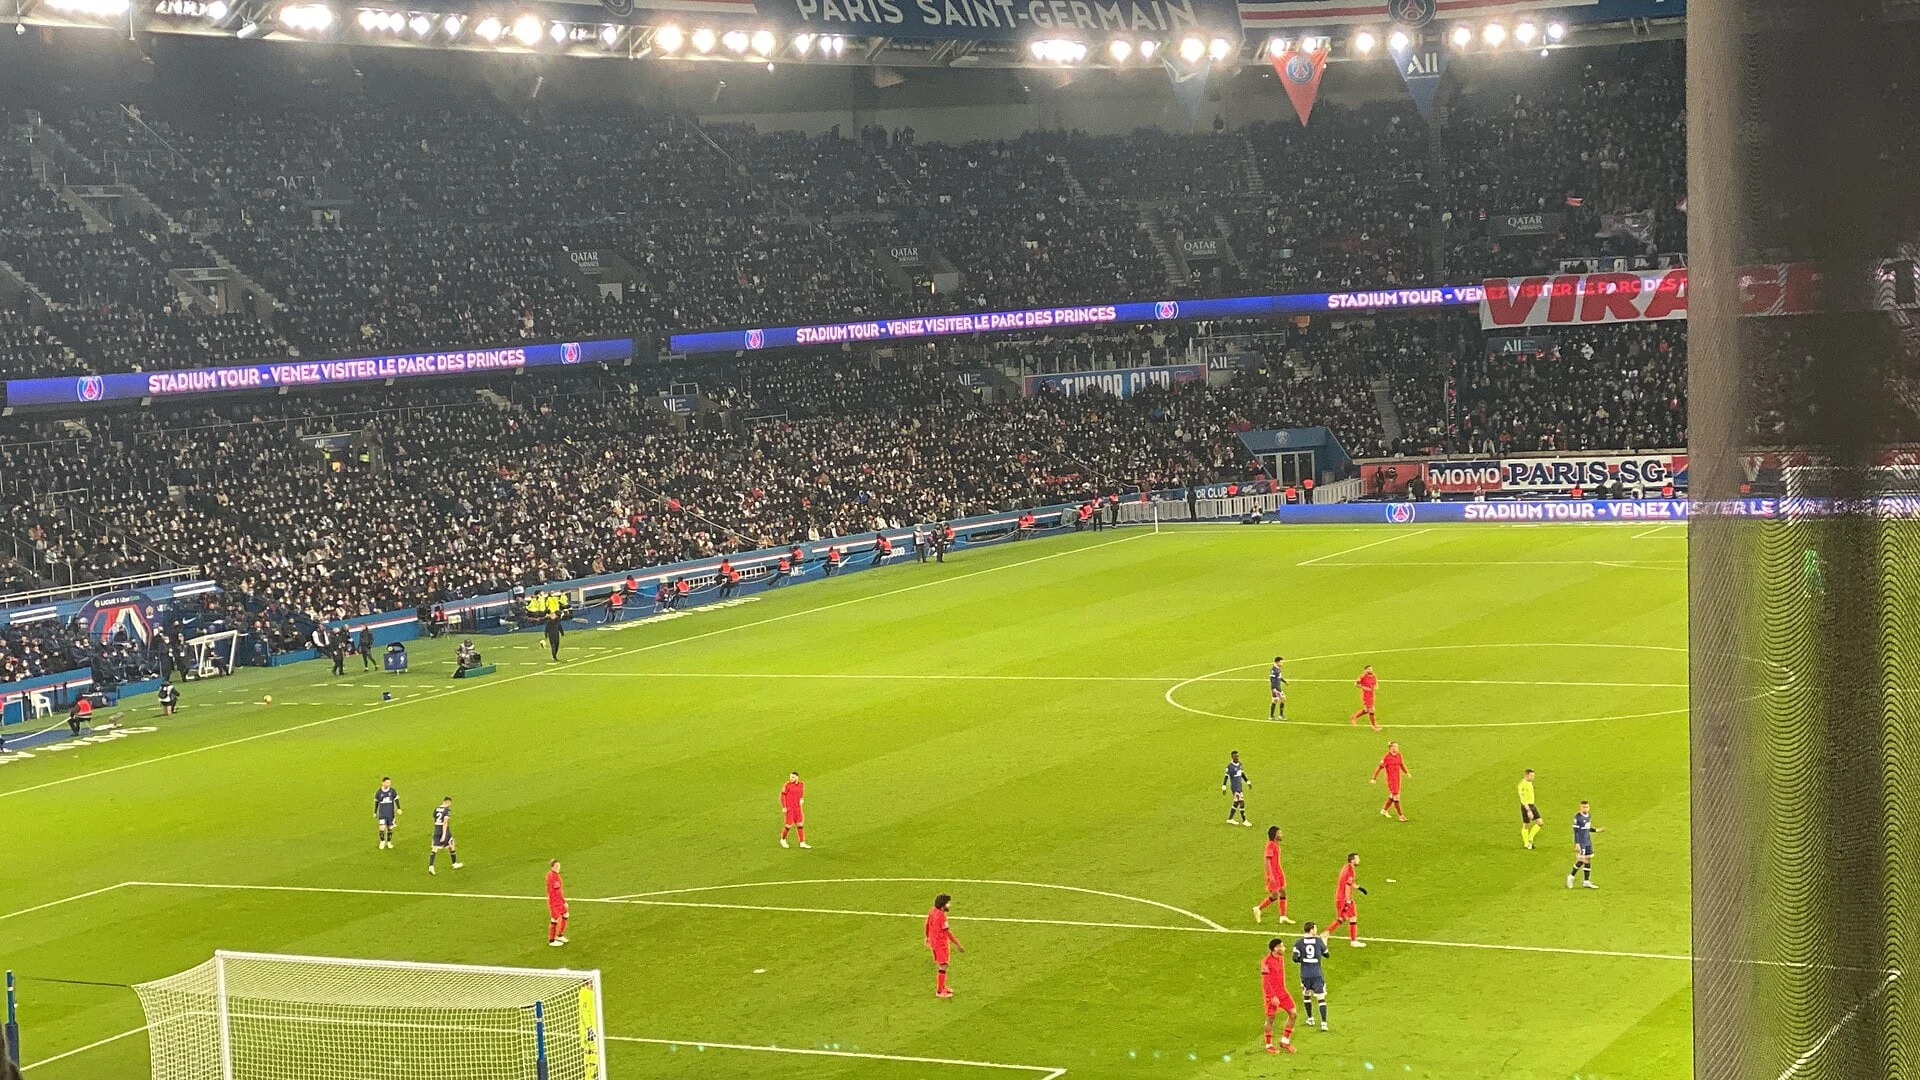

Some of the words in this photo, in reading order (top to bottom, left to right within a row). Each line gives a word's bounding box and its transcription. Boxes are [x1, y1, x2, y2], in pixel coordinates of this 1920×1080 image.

[797, 0, 904, 24] PARIS
[917, 0, 1201, 31] SAINT-GERMAIN
[1507, 215, 1543, 227] QATAR
[890, 247, 918, 259] QATAR
[1183, 240, 1217, 251] QATAR
[570, 251, 599, 264] QATAR
[1327, 293, 1397, 308] STADIUM
[1398, 290, 1443, 305] TOUR
[1453, 286, 1507, 301] VENEZ
[796, 327, 847, 343] STADIUM
[849, 324, 880, 338] TOUR
[887, 319, 924, 335] VENEZ
[924, 317, 973, 333] VISITER
[974, 316, 990, 330] LE
[991, 313, 1024, 328] PARC
[1025, 311, 1053, 325] DES
[1054, 306, 1117, 323] PRINCES
[148, 371, 217, 394] STADIUM
[217, 368, 260, 387] TOUR
[270, 364, 320, 383] VENEZ
[321, 360, 377, 380] VISITER
[379, 359, 396, 376] LE
[397, 356, 435, 374] PARC
[437, 353, 465, 371] DES
[466, 349, 525, 368] PRINCES
[1429, 466, 1501, 486] MOMO
[1508, 460, 1611, 486] PARIS
[1617, 459, 1667, 483] SG
[1464, 503, 1543, 519] STADIUM
[1544, 502, 1595, 518] TOUR
[1607, 501, 1670, 517] VENEZ
[1750, 500, 1775, 516] LE
[435, 812, 443, 823] 2
[1305, 944, 1315, 959] 9
